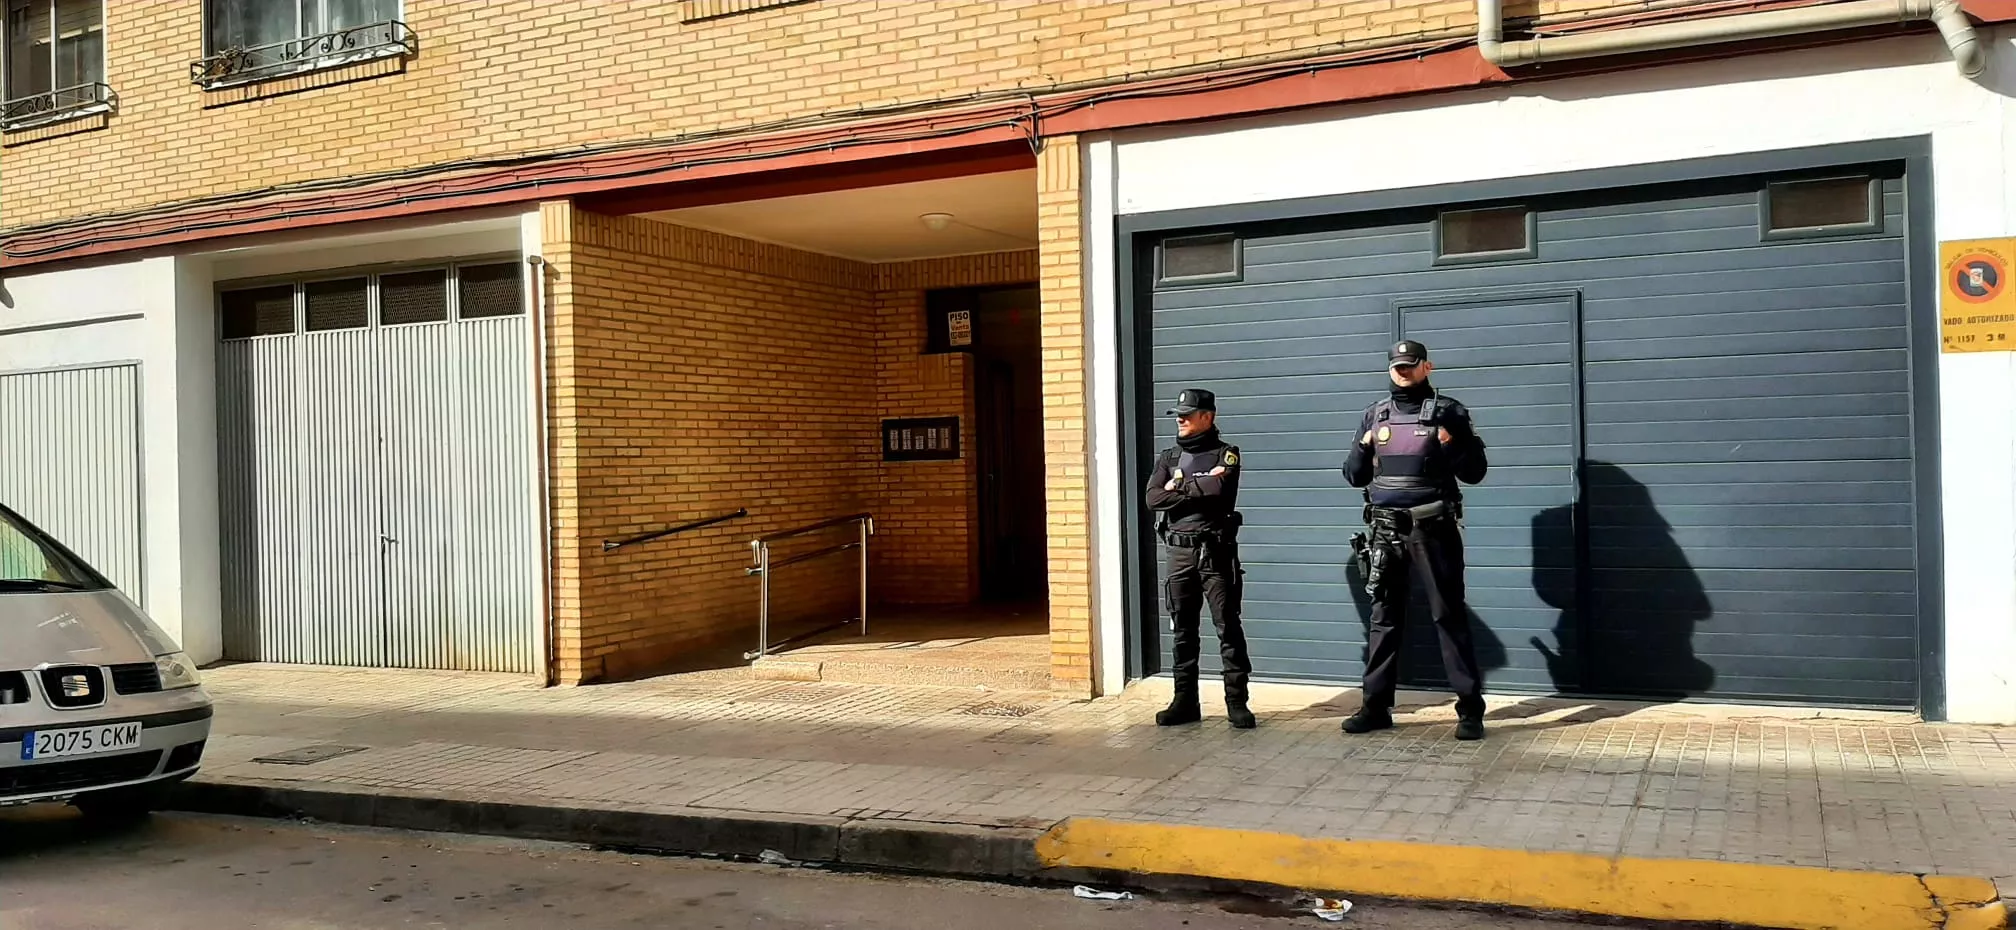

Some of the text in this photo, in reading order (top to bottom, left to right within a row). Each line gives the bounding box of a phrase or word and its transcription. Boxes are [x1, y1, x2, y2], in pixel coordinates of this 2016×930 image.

[950, 312, 968, 321] PISO
[1943, 317, 1962, 325] VADO
[1957, 334, 1975, 343] 1157
[38, 725, 138, 754] 2075 CKM
